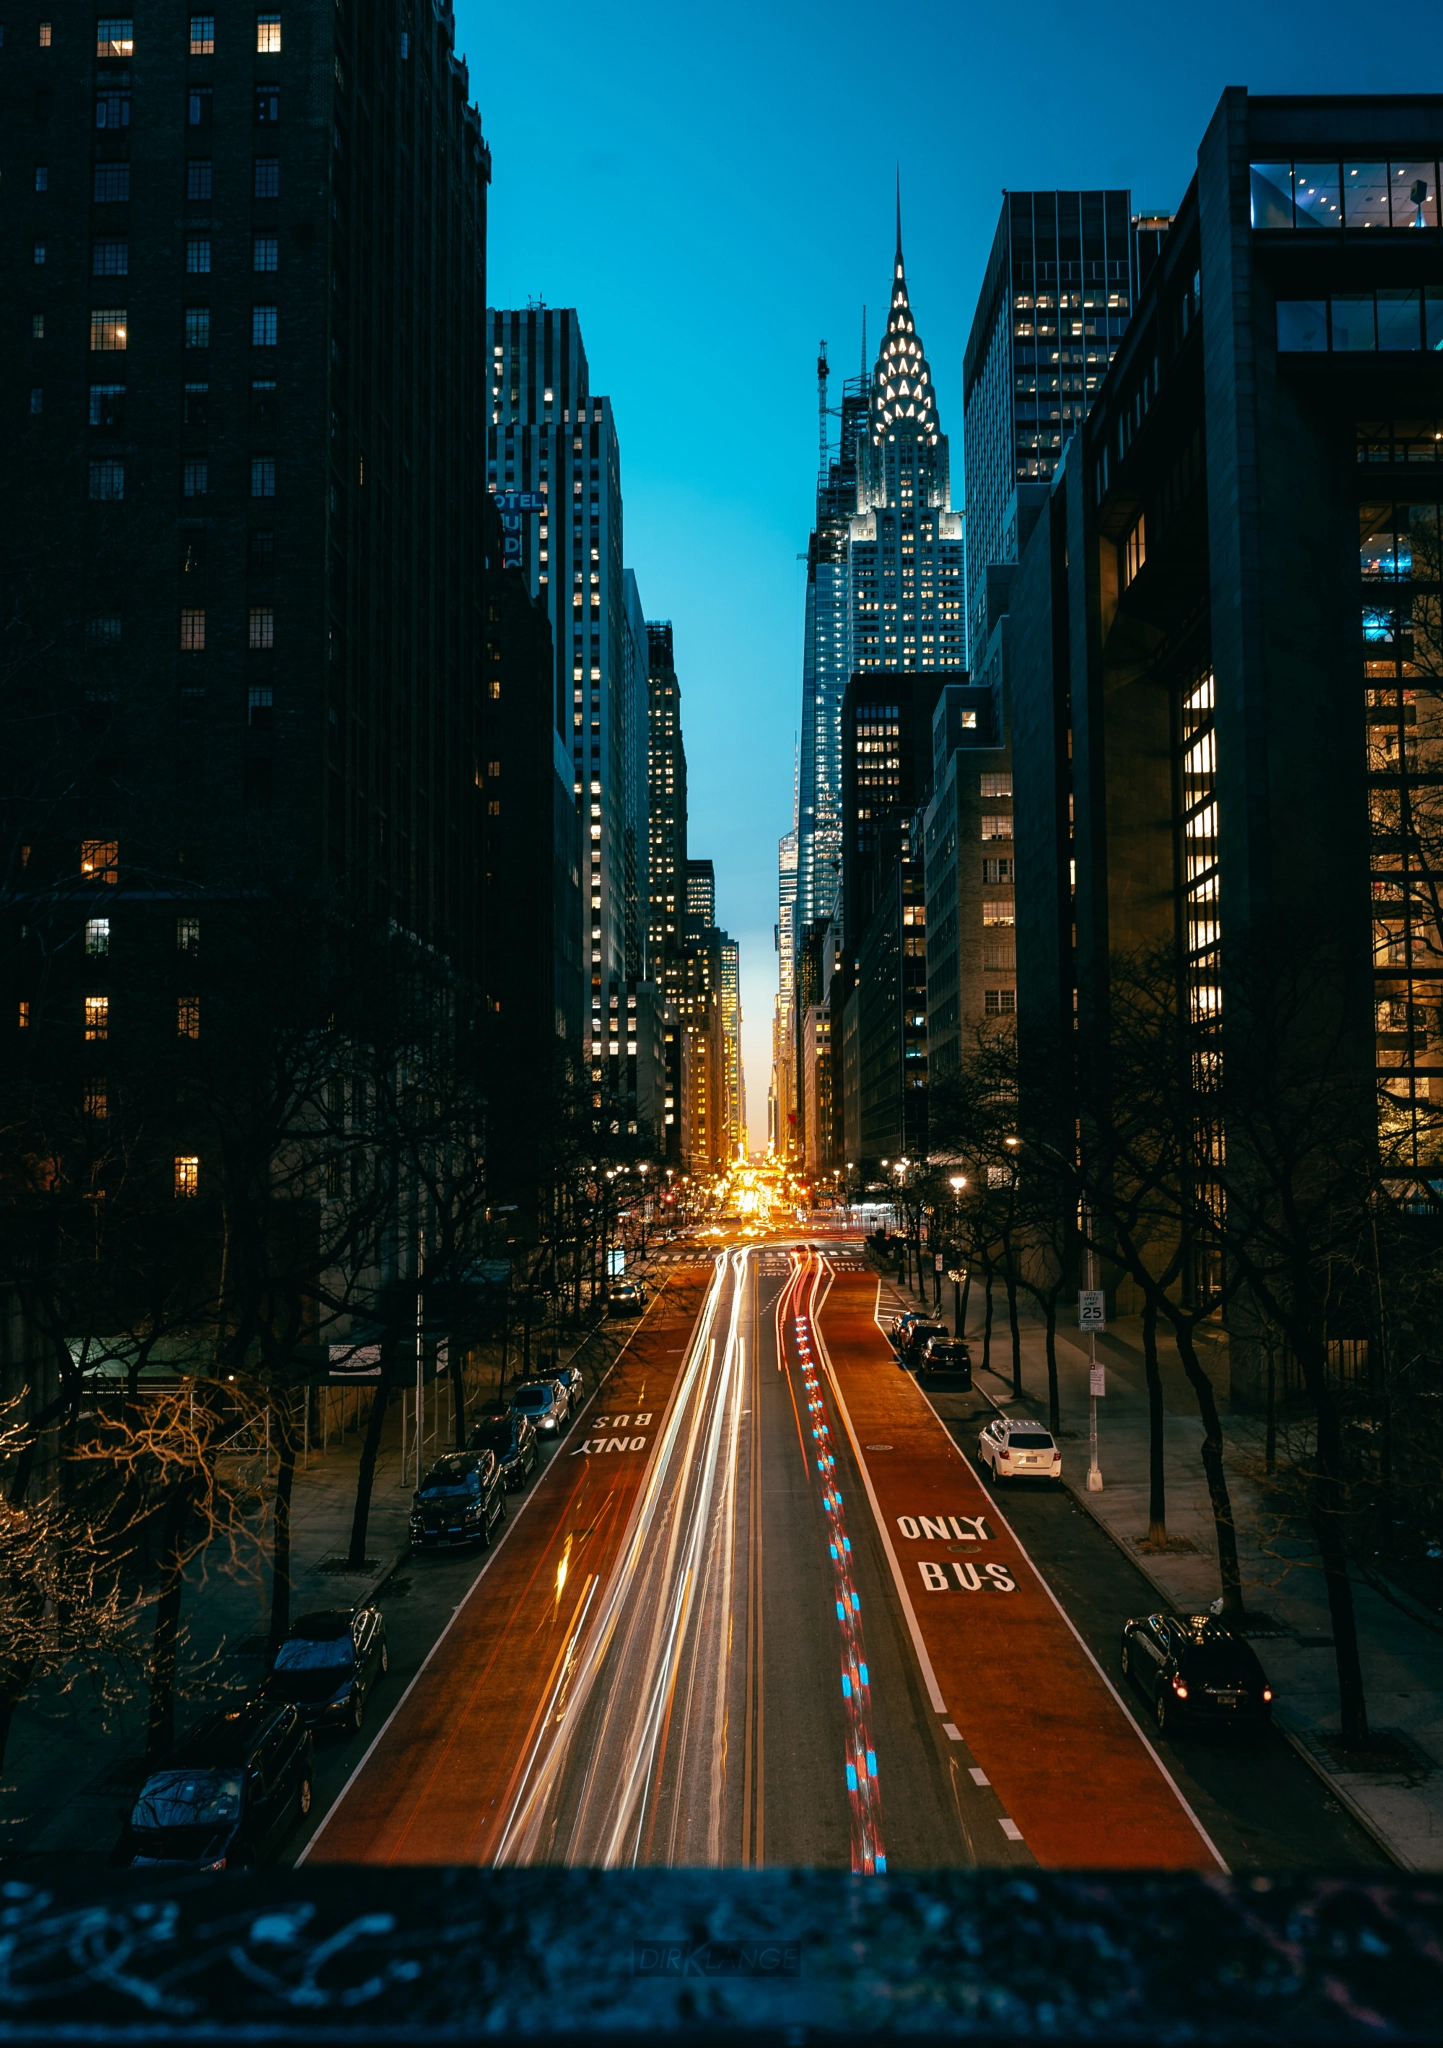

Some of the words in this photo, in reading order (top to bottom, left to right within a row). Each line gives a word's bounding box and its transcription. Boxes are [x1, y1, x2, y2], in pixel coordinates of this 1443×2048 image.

[494, 493, 542, 508] OTEL
[1082, 1307, 1102, 1319] 25
[592, 1413, 653, 1428] BUS
[569, 1436, 646, 1456] ONLY
[897, 1516, 988, 1540] ONLY
[917, 1561, 1016, 1592] BUS
